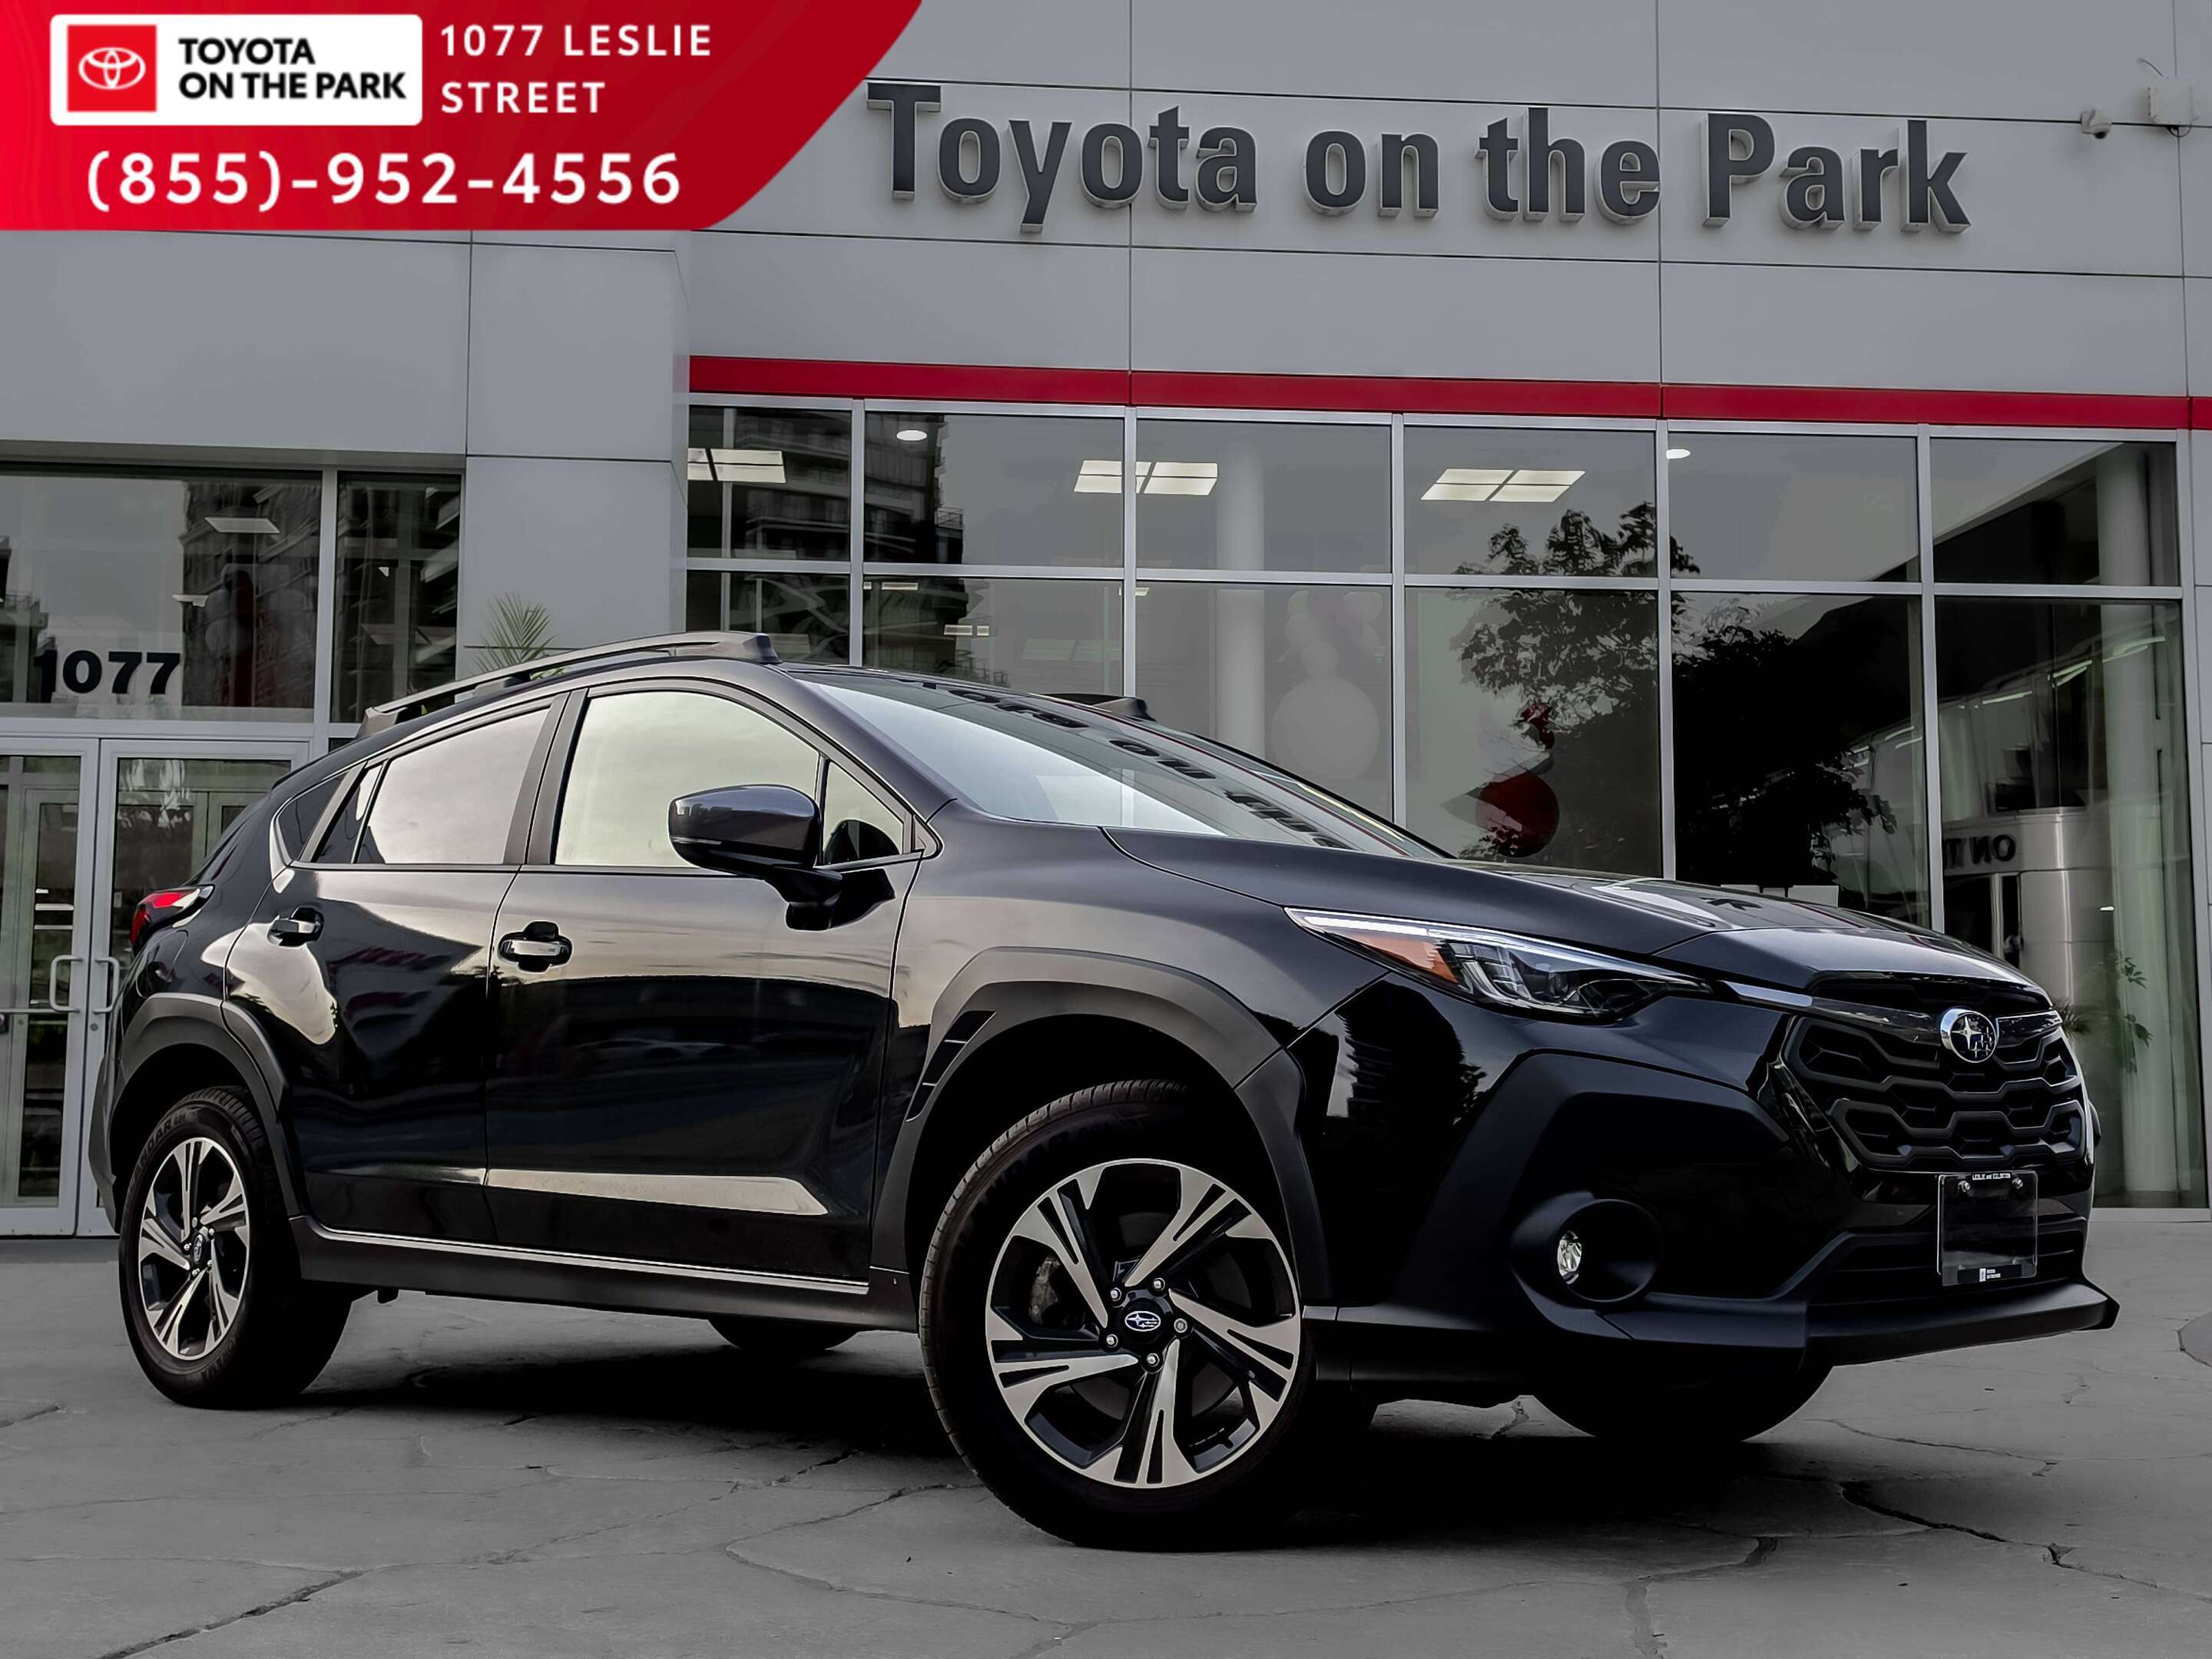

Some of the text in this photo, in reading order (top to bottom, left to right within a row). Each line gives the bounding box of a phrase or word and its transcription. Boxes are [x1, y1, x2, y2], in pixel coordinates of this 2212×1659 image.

[866, 81, 1972, 234] Toyota on the Park
[35, 649, 181, 694] 1077
